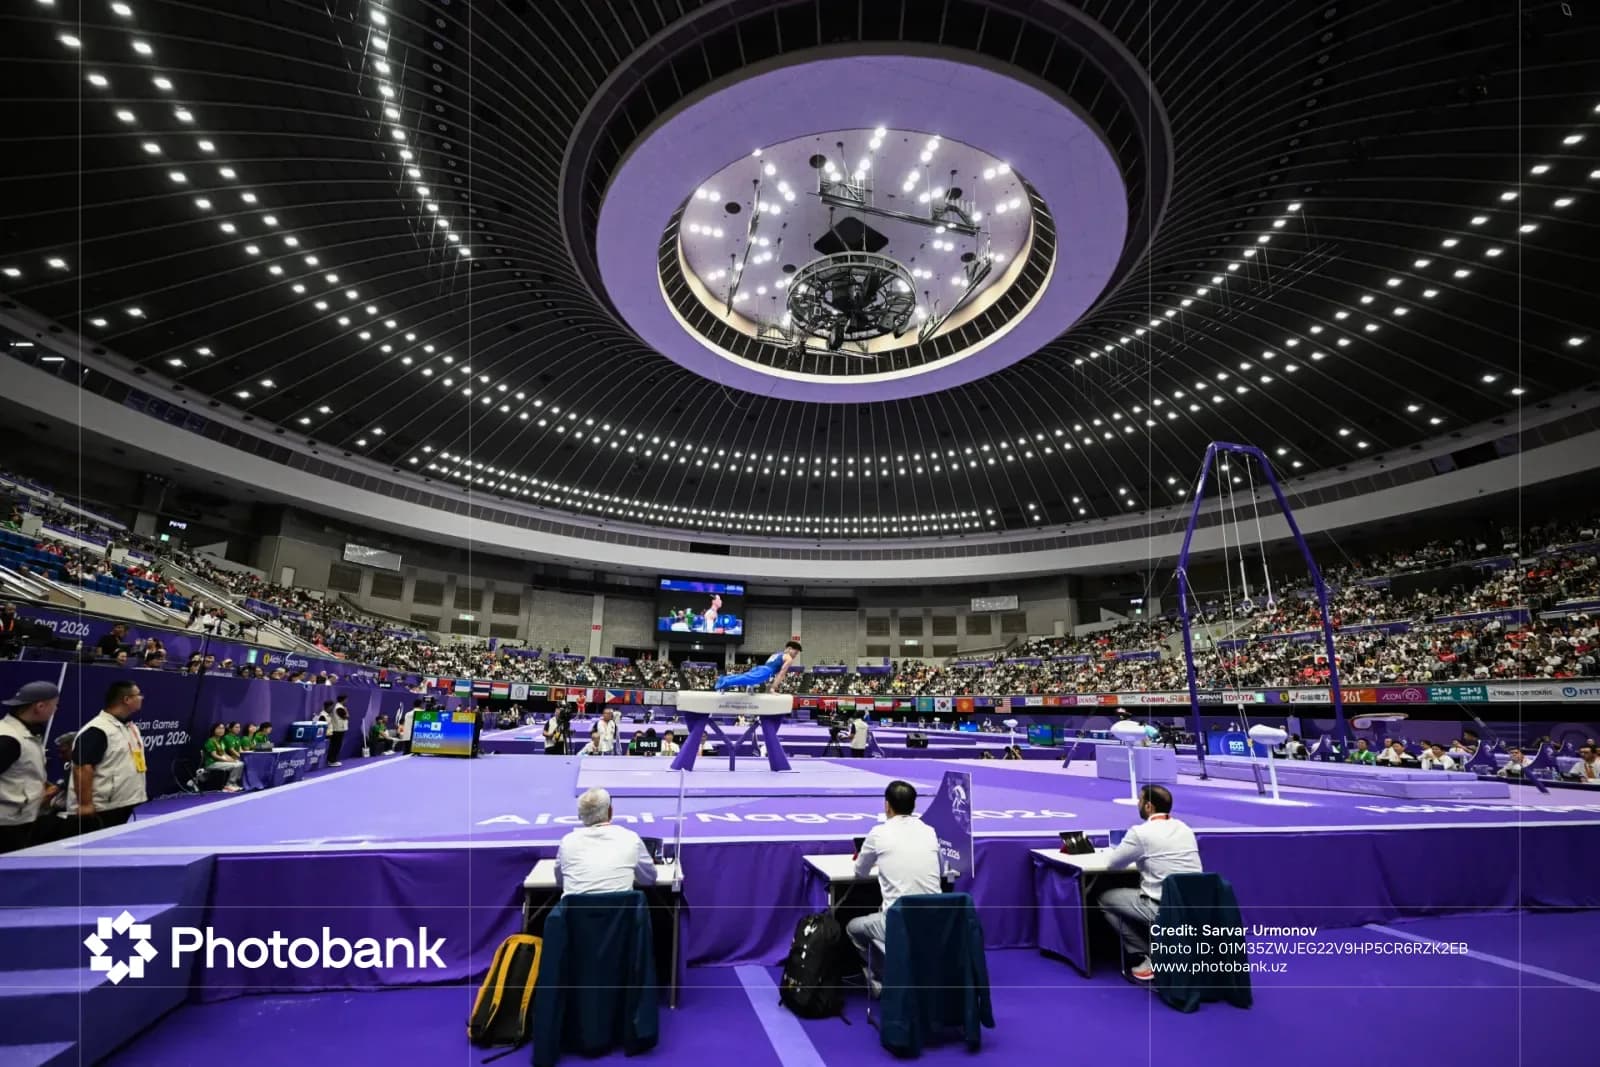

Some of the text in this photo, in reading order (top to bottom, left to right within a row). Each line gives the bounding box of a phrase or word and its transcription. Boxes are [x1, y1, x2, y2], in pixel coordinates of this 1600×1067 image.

[60, 620, 90, 637] 2026
[1141, 695, 1165, 703] Canon
[1224, 694, 1254, 702] TOYOTA
[152, 719, 180, 730] Games
[972, 809, 1078, 819] 026
